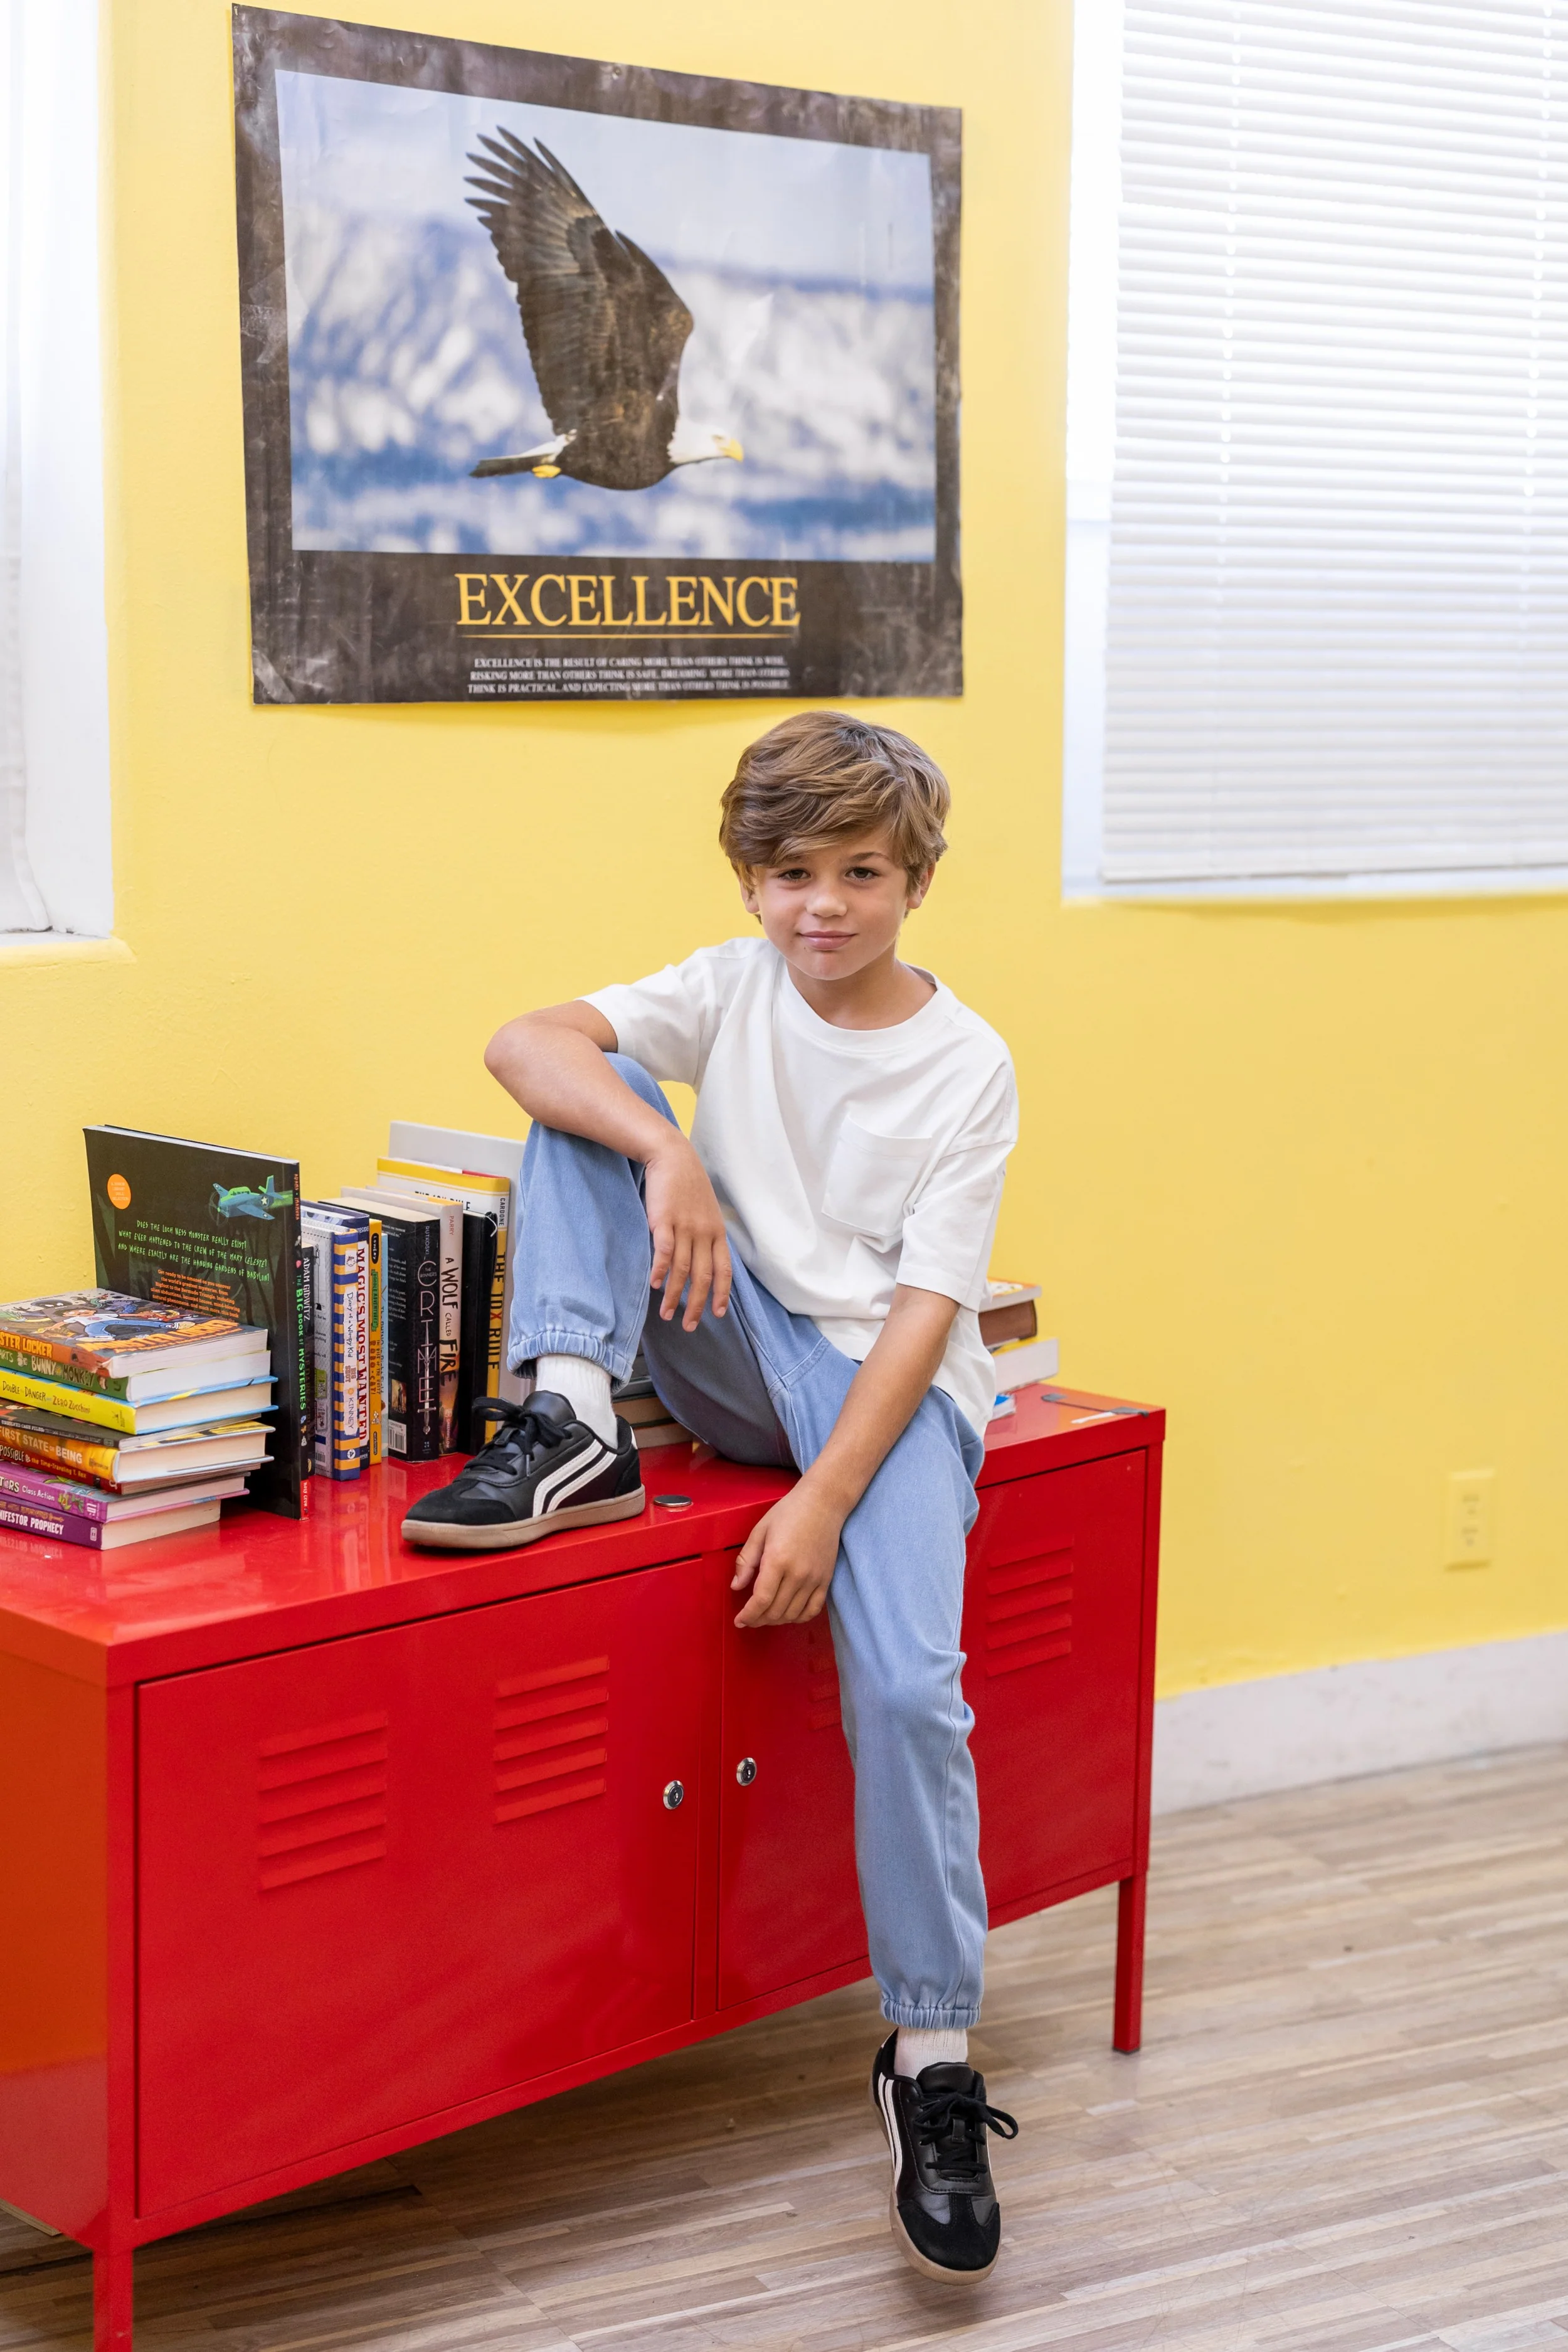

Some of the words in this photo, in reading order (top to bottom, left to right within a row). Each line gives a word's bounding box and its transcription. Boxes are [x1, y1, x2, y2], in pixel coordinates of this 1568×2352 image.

[455, 573, 802, 627] EXCELLENCE
[470, 671, 507, 681] RISKING
[509, 671, 534, 681] MORE
[537, 670, 562, 680] THAN
[563, 670, 597, 679] OTHERS
[598, 669, 625, 679] THINK
[709, 668, 733, 678] MORE
[474, 658, 532, 668] EXCELLENCE
[534, 658, 543, 668] IS
[544, 657, 562, 668] THE
[563, 657, 595, 668] RESULT
[642, 656, 669, 666] MORE
[467, 683, 495, 694] THINK
[497, 683, 507, 693] IS
[561, 683, 582, 693] AND
[582, 682, 630, 693] EXPECTING
[119, 1230, 132, 1239] WHAT
[134, 1233, 147, 1242] EVER
[149, 1236, 172, 1247] HAPPENED
[182, 1243, 191, 1252] THE
[194, 1245, 207, 1255] CREW
[217, 1250, 226, 1259] THE
[230, 1253, 243, 1262] MARY
[245, 1256, 267, 1269] CELESTE?
[137, 1220, 148, 1228] DOES
[151, 1223, 160, 1232] THE
[162, 1225, 173, 1234] LOCH
[175, 1228, 186, 1236] NESS
[189, 1230, 209, 1241] MONSTER
[211, 1235, 229, 1245] REALLY
[231, 1240, 246, 1250] EXIST?
[129, 1245, 146, 1255] WHERE
[148, 1249, 167, 1260] EXACTLY
[169, 1253, 179, 1262] ARE
[181, 1256, 191, 1265] THE
[193, 1259, 213, 1269] HANGING
[215, 1262, 236, 1274] GARDENS
[238, 1269, 245, 1277] OF
[246, 1270, 270, 1284] BABYLON?
[181, 1287, 198, 1296] Bermuda
[358, 1248, 366, 1316] MAGIC'S
[441, 1267, 459, 1309] WOLF
[303, 1284, 312, 1321] GIDWITZ
[358, 1317, 366, 1365] MOST
[417, 1260, 437, 1403] CRIME
[22, 1337, 53, 1359] LOCKER
[439, 1339, 458, 1386] FIRE
[31, 1355, 56, 1376] BUNNY
[63, 1364, 93, 1387] MONKEY
[3, 1381, 20, 1394] DOUBLE
[24, 1386, 46, 1402] DANGER
[53, 1395, 68, 1407] ZERO
[357, 1366, 367, 1440] WANTED
[0, 1444, 24, 1462] POSSIBLE
[41, 1459, 73, 1475] Time-Traveling
[23, 1434, 49, 1453] STATE
[56, 1445, 82, 1464] BEING
[22, 1485, 36, 1496] Class
[37, 1489, 55, 1501] Action
[30, 1518, 64, 1535] PROPHECY
